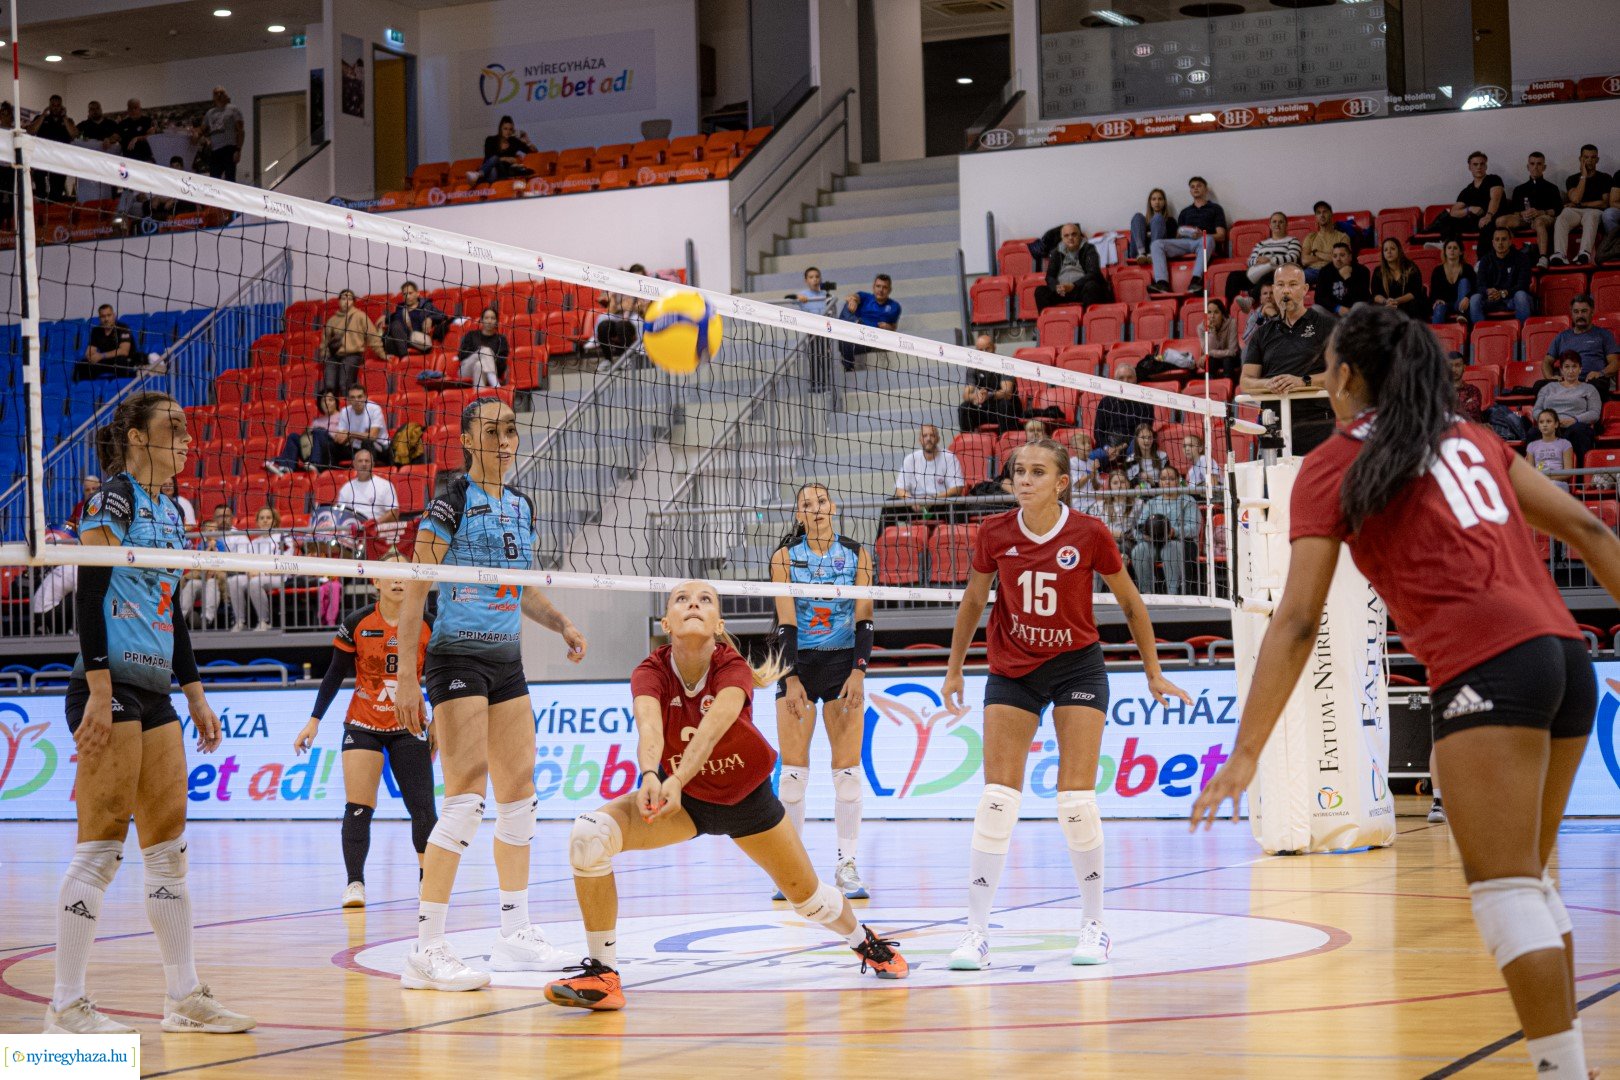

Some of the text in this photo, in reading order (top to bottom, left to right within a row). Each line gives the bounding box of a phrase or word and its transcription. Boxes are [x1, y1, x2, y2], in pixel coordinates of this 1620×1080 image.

[524, 58, 606, 75] NYÍREGYHÁZA
[524, 69, 634, 102] Többet ad!
[1531, 81, 1564, 91] Holding
[1404, 92, 1435, 101] Holding
[1521, 90, 1555, 101] Csoport
[1258, 103, 1308, 115] Bige Holding
[1394, 102, 1426, 112] Csoport
[1136, 113, 1185, 126] Bige Holding
[1267, 113, 1299, 123] Csoport
[1145, 124, 1176, 134] Csoport
[263, 195, 295, 216] FATUM
[467, 240, 493, 261] FATUM
[638, 280, 660, 296] FATUM
[1420, 437, 1509, 529] 16
[105, 505, 122, 517] LUGOJ
[431, 510, 446, 522] LUGOJ
[503, 532, 518, 560] 6
[274, 557, 299, 571] FATUM
[478, 570, 498, 583] FATUM
[1017, 570, 1057, 617] 15
[1009, 613, 1073, 642] FATUM
[458, 630, 508, 642] PRIMĂRIA
[385, 653, 399, 674] 8
[248, 747, 337, 802] ad!
[64, 904, 96, 922] PEAK
